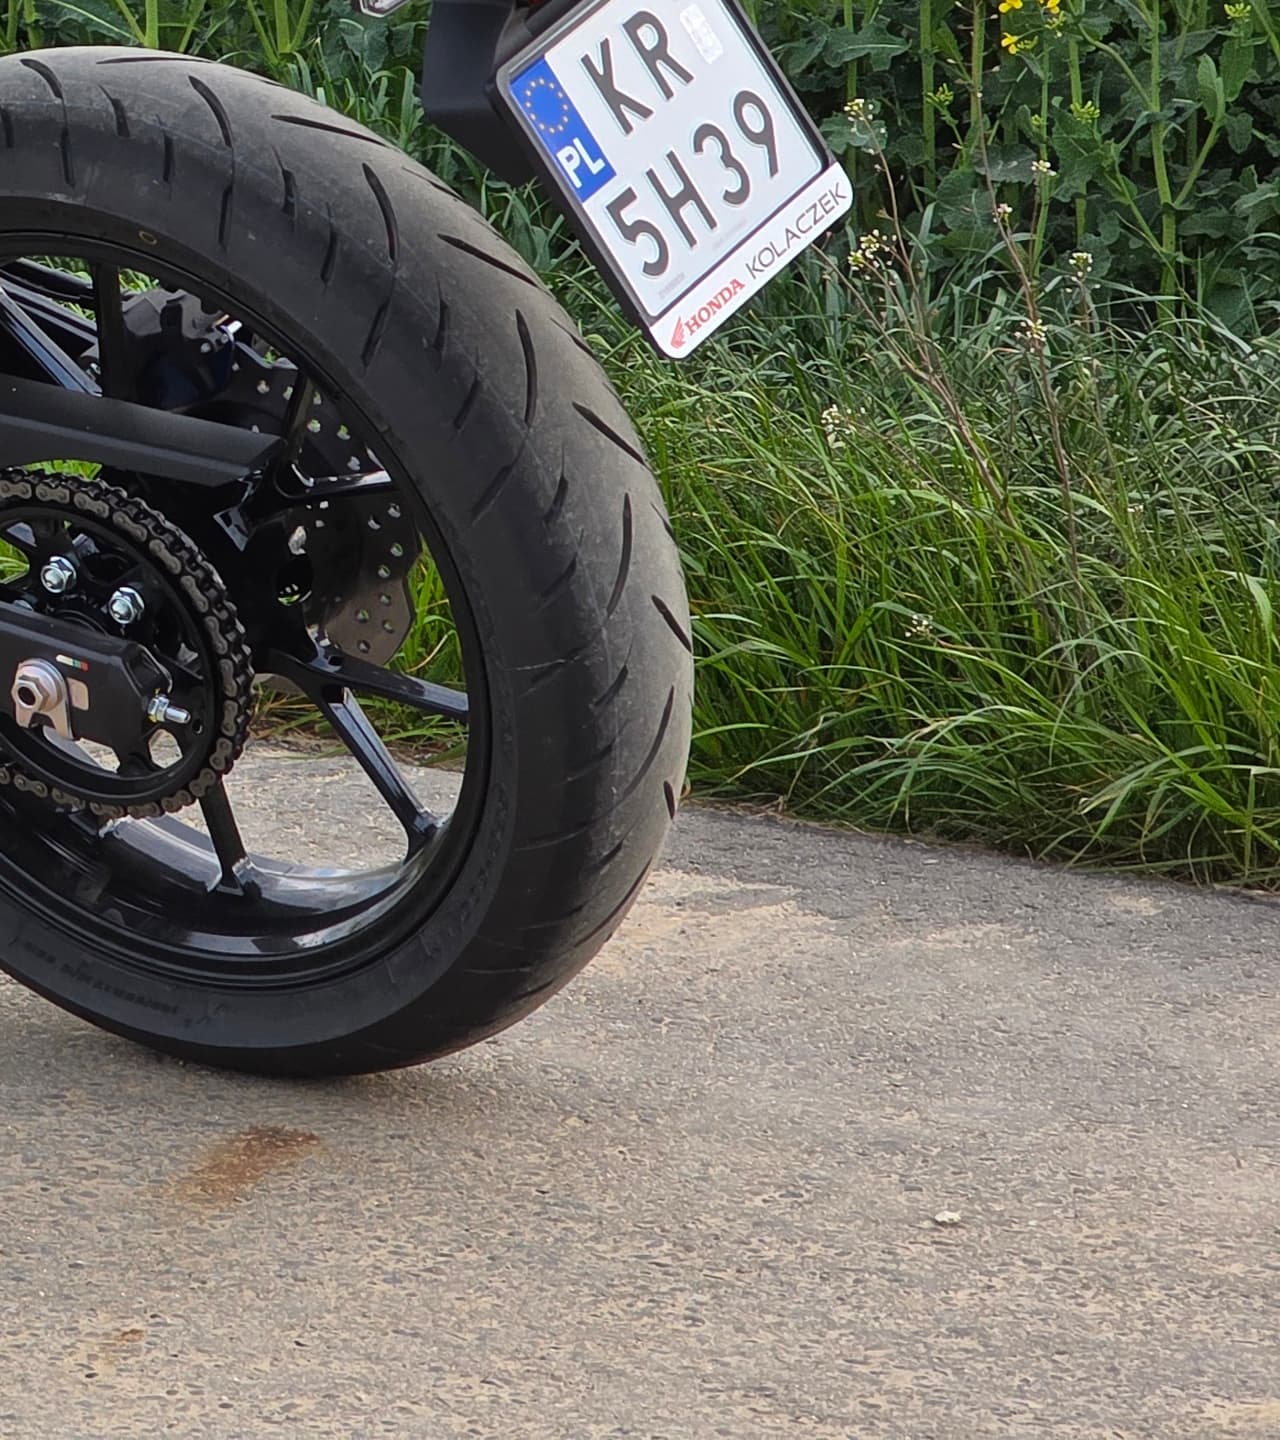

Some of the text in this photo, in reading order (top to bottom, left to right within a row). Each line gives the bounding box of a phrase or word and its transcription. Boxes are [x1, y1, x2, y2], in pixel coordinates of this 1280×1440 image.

[580, 10, 693, 135] KR
[557, 136, 605, 189] PL
[606, 90, 778, 277] 5H39
[684, 182, 847, 336] HONDA KOLACZEK
